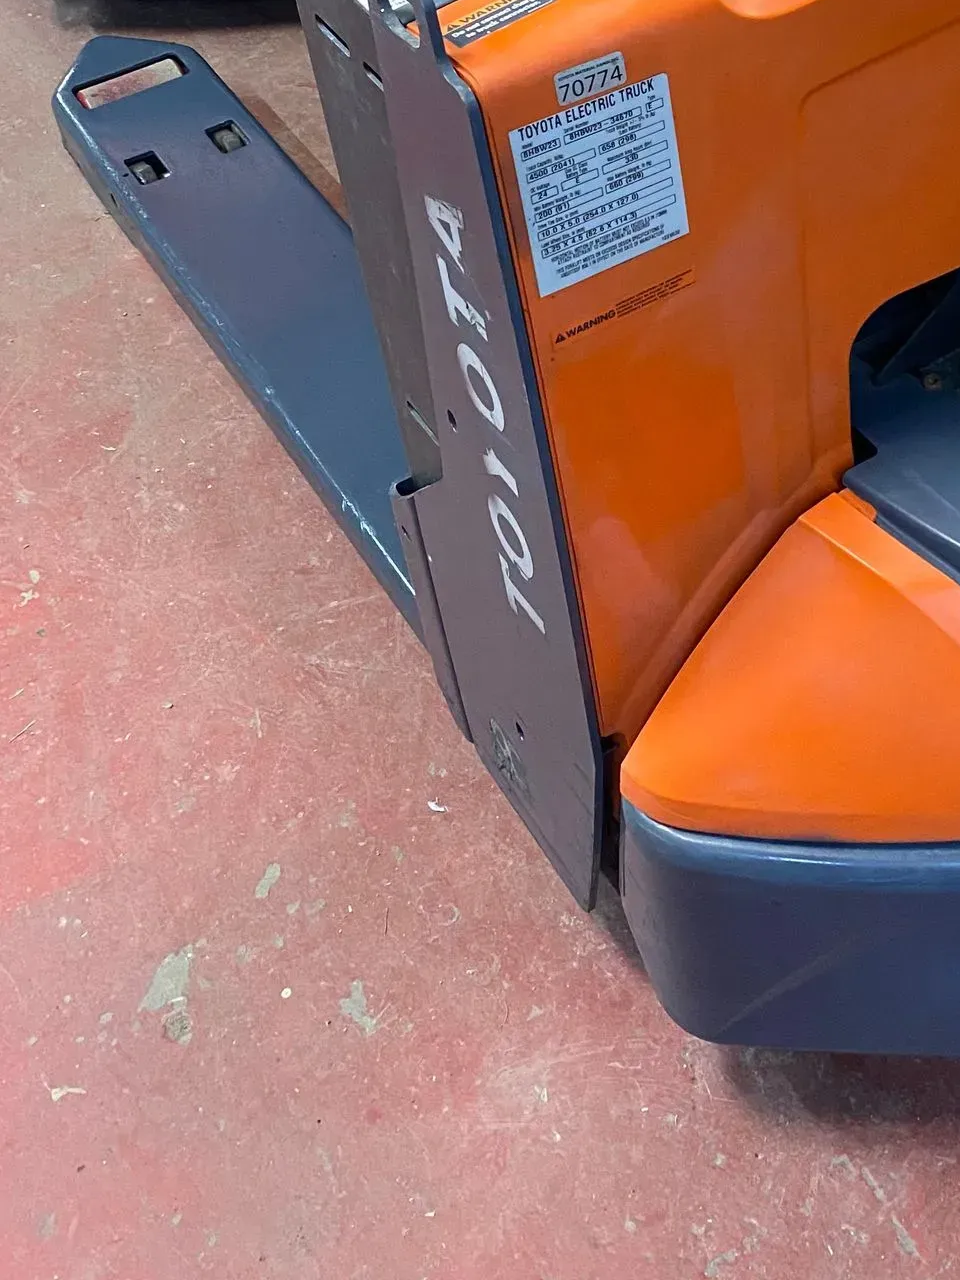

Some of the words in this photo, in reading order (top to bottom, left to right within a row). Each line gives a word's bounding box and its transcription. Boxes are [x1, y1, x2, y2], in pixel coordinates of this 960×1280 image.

[452, 30, 465, 38] Do
[466, 22, 480, 32] not
[480, 8, 511, 24] connect
[476, 20, 500, 32] truck
[558, 64, 623, 102] 70774
[518, 115, 561, 140] TOYOTA
[566, 94, 615, 122] ELECTRIC
[620, 79, 653, 101] TRUCK
[569, 122, 602, 139] 8HBW23
[523, 139, 557, 158] 8HBW23
[624, 152, 638, 163] 330
[530, 168, 548, 180] 4500
[551, 157, 574, 172] (2041)
[608, 178, 623, 189] 660
[537, 189, 547, 199] 24
[538, 208, 552, 219] 200
[555, 200, 570, 213] (91)
[542, 226, 557, 237] 10.0
[568, 217, 580, 226] 5.0
[582, 206, 606, 221] (254.0
[616, 192, 638, 206] 127.0)
[544, 243, 560, 255] 3.25
[571, 234, 583, 243] 4.5
[565, 309, 616, 338] WARNING
